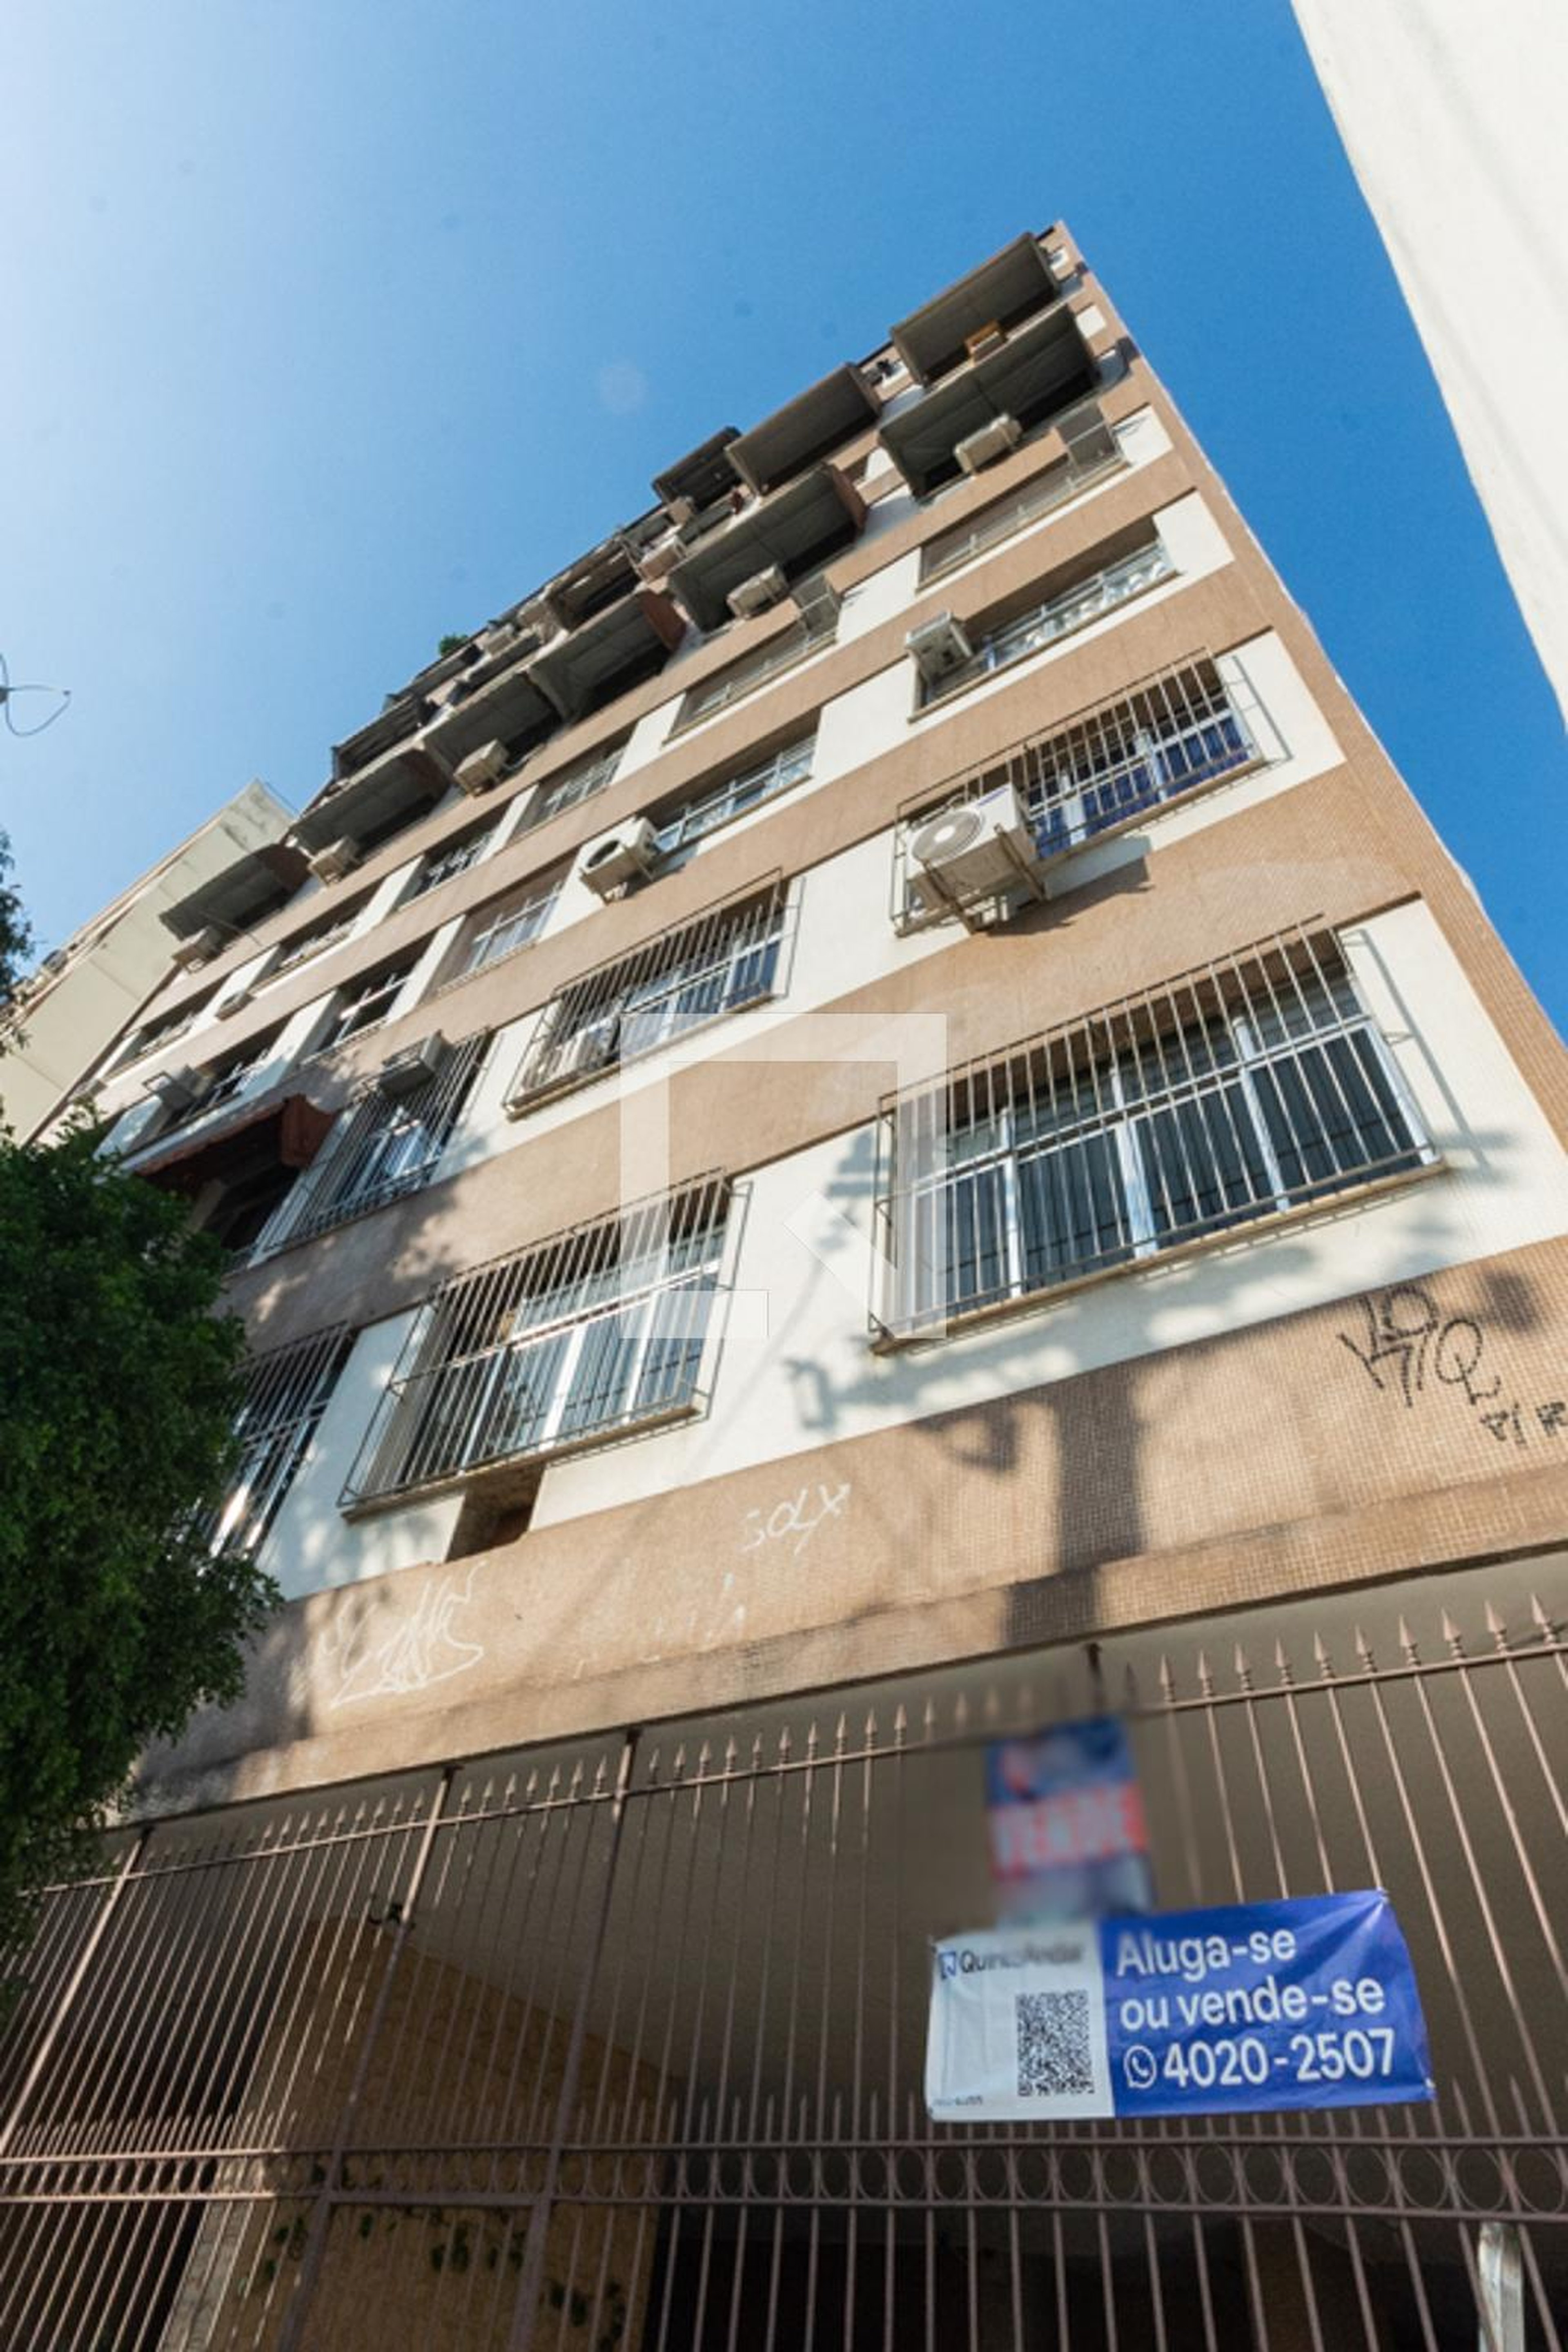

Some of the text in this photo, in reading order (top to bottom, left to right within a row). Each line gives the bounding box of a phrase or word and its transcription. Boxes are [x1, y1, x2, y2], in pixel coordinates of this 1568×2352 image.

[1117, 1928, 1296, 1983] Aluga-se
[1120, 1974, 1385, 2030] ou vende-se
[1163, 2027, 1395, 2088] 4020-2507
